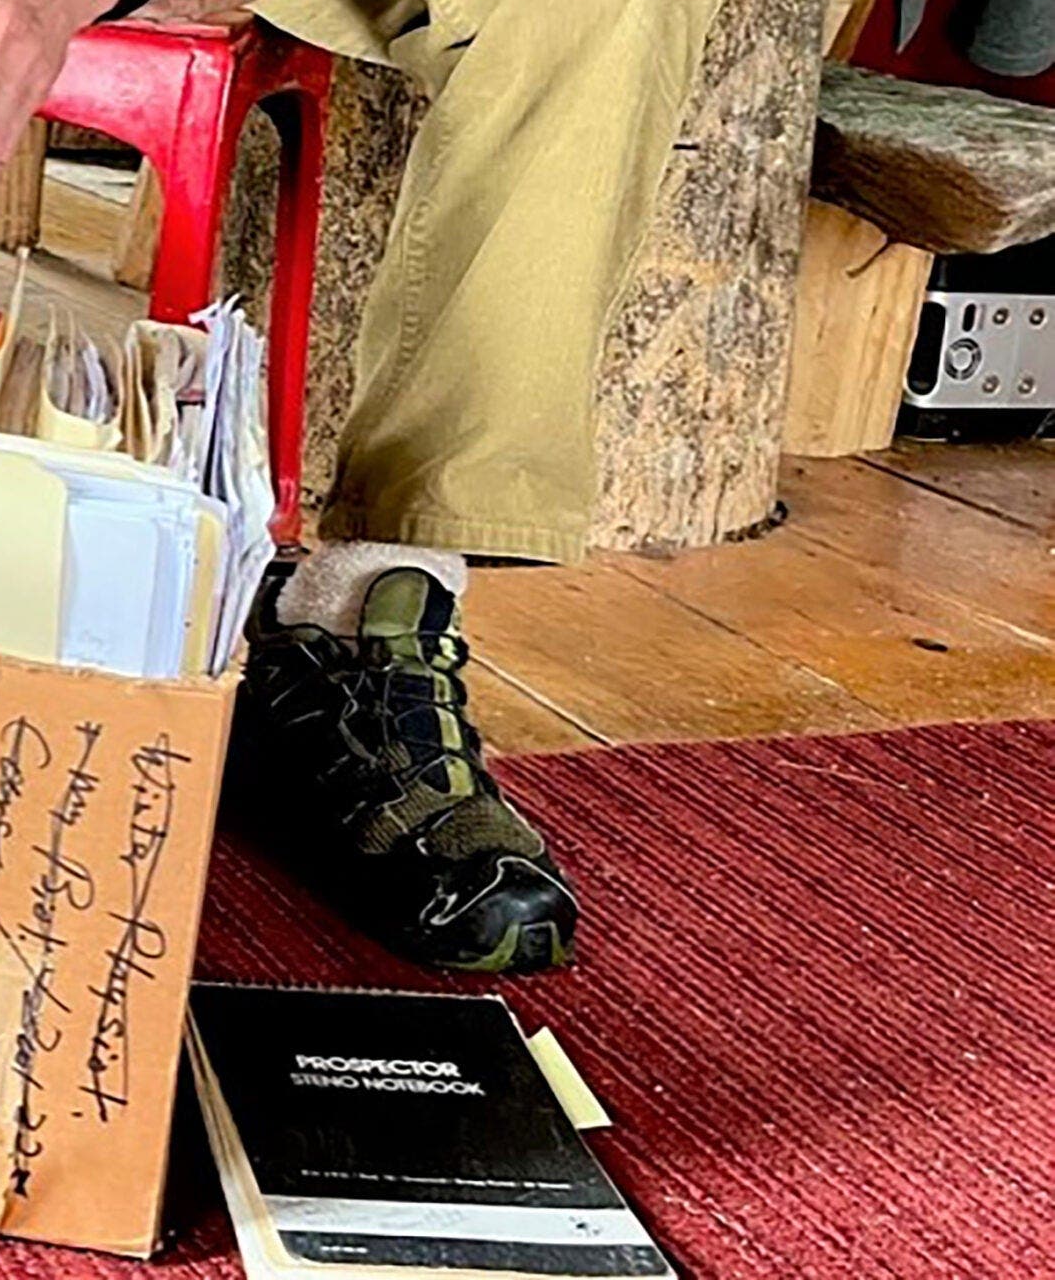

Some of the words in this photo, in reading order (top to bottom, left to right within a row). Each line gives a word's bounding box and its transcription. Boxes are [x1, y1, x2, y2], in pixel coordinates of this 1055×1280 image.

[295, 1054, 462, 1078] PROSPECTOR
[289, 1072, 360, 1089] STENO
[361, 1076, 487, 1096] NOTEBOOK
